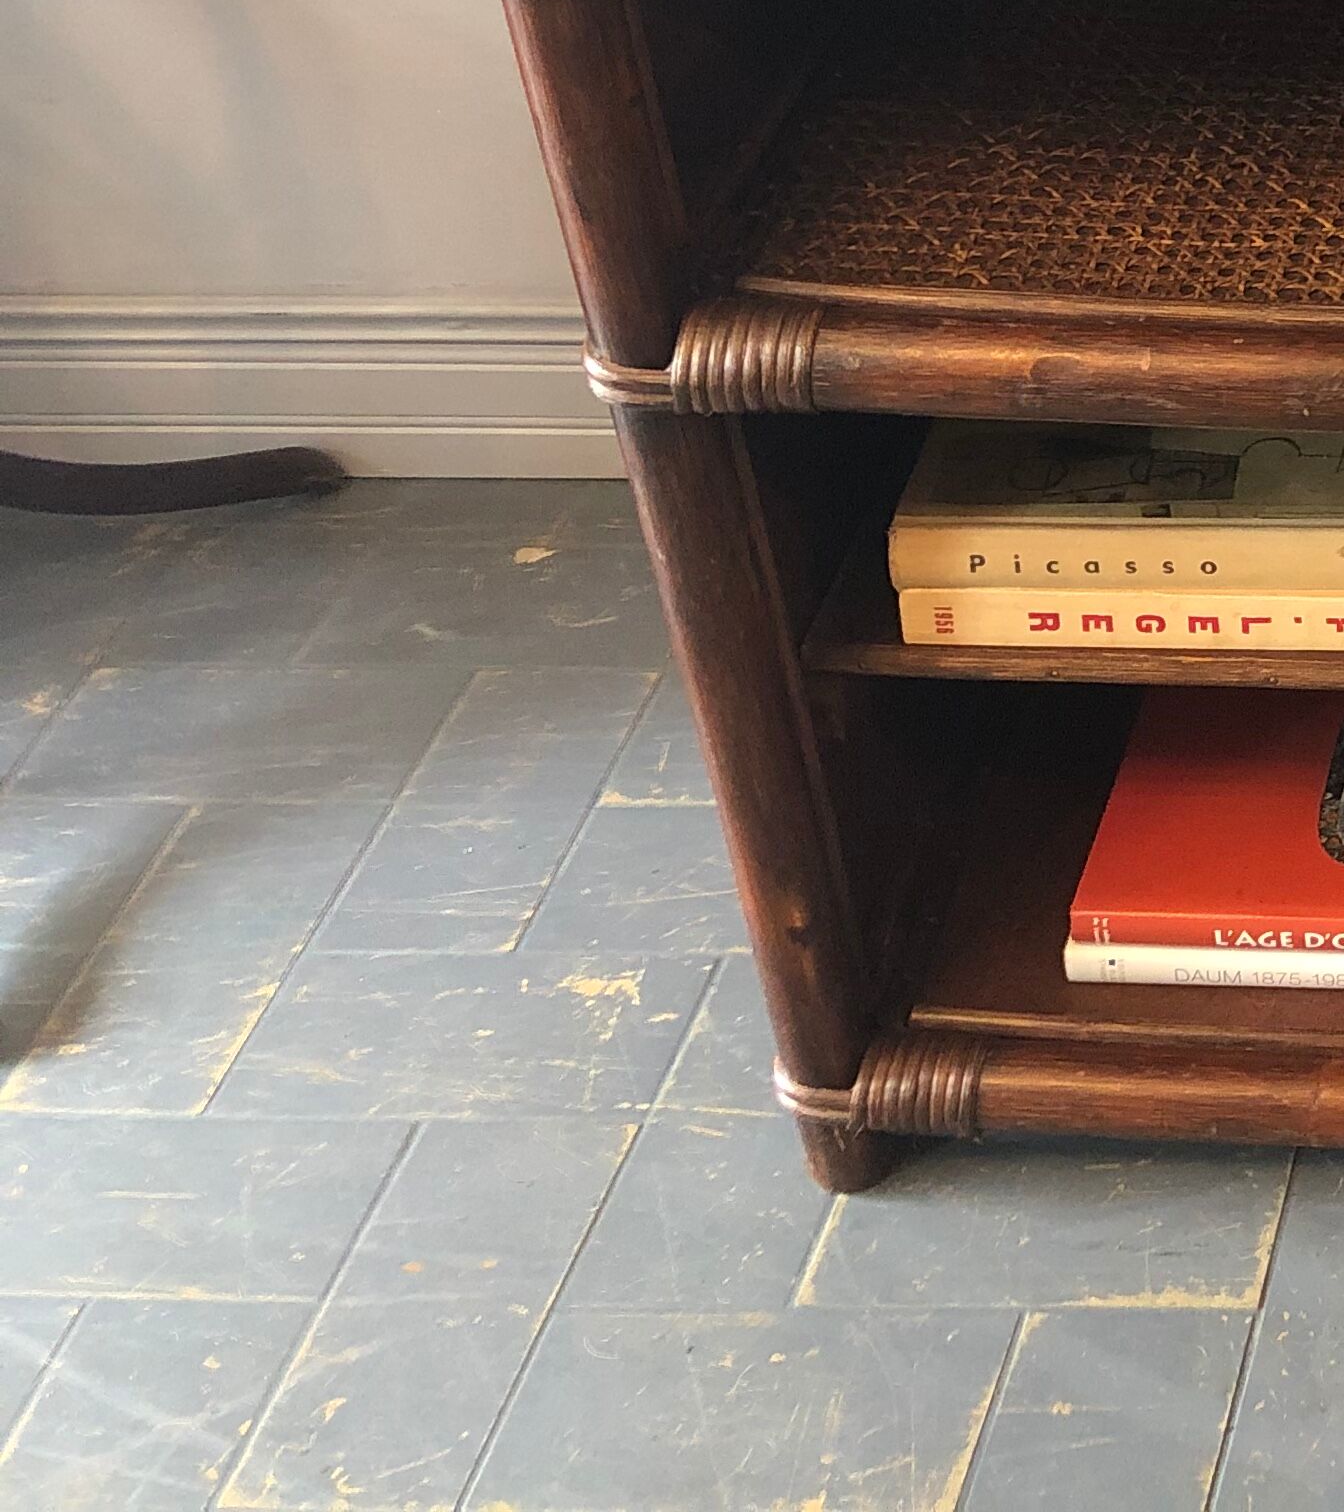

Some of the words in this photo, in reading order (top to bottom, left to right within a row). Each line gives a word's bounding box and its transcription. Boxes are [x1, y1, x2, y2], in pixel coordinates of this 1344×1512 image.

[969, 554, 1218, 574] Picasso
[933, 606, 955, 635] 1956
[1213, 930, 1294, 948] L'AGE
[1174, 968, 1243, 985] DAUM
